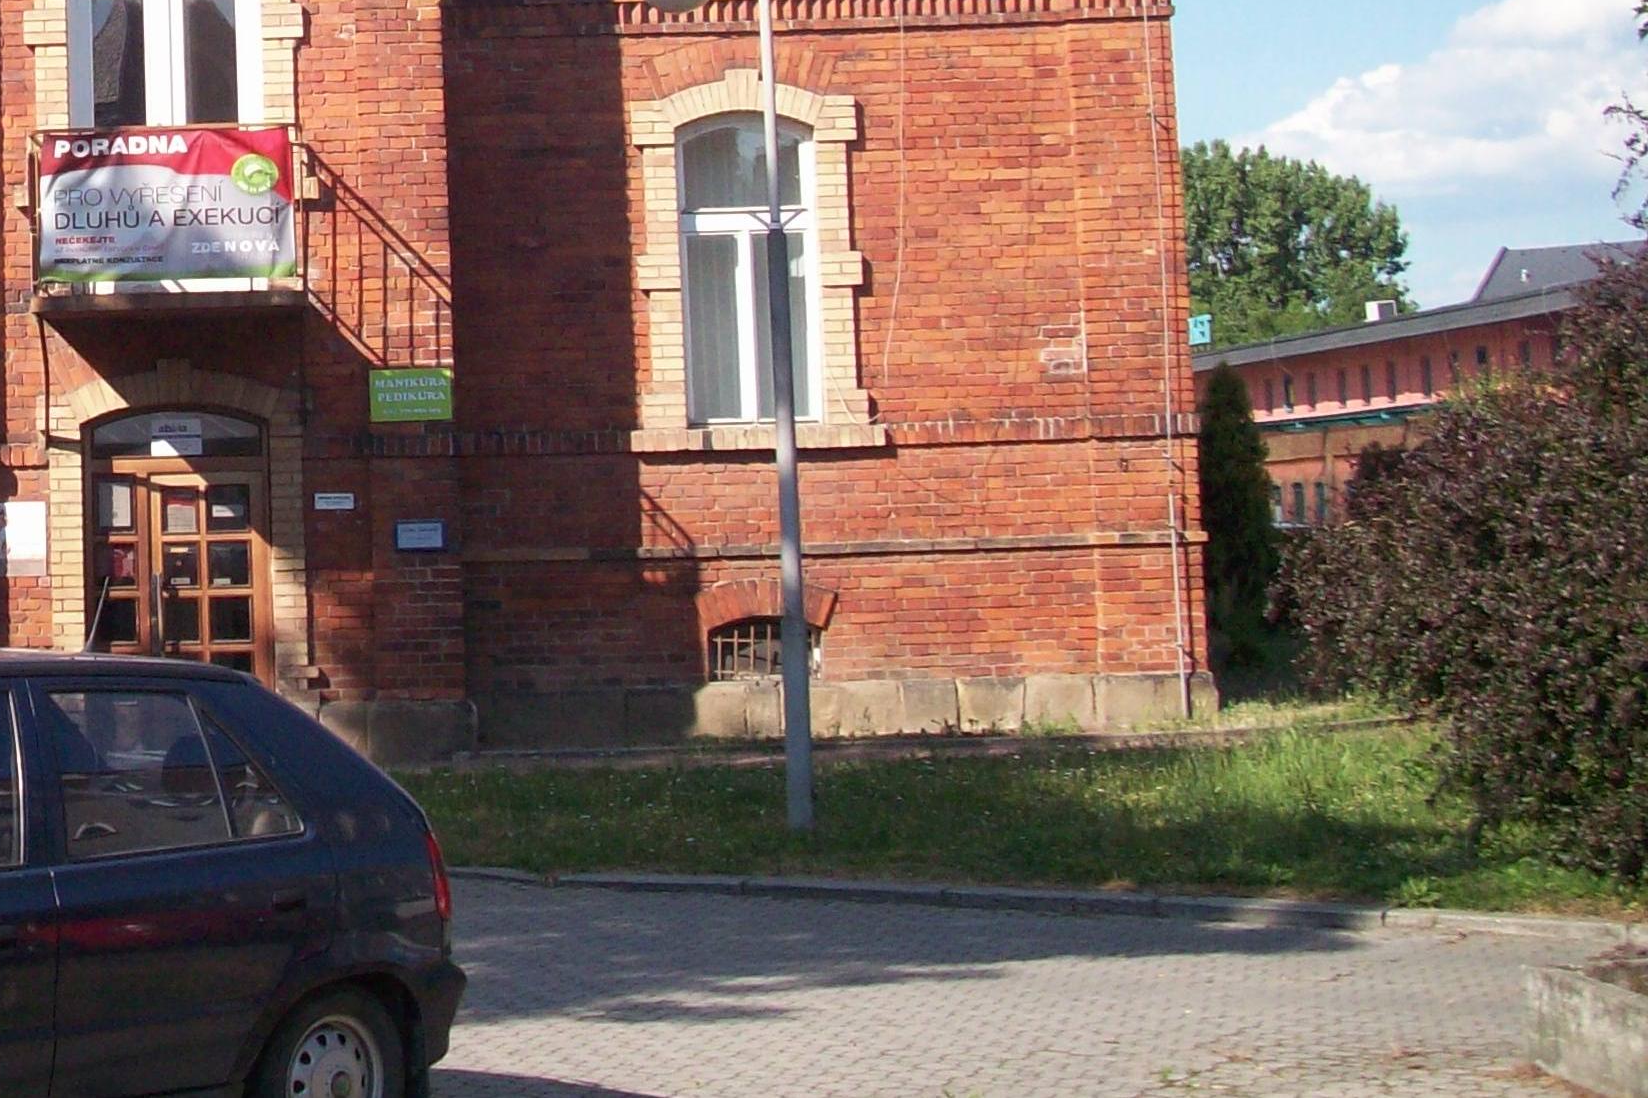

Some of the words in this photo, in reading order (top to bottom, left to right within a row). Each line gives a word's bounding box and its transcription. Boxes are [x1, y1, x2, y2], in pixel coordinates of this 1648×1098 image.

[54, 134, 188, 159] PORADNA
[54, 188, 103, 206] PRO
[54, 205, 140, 230] DLUHŮ
[148, 210, 165, 227] A
